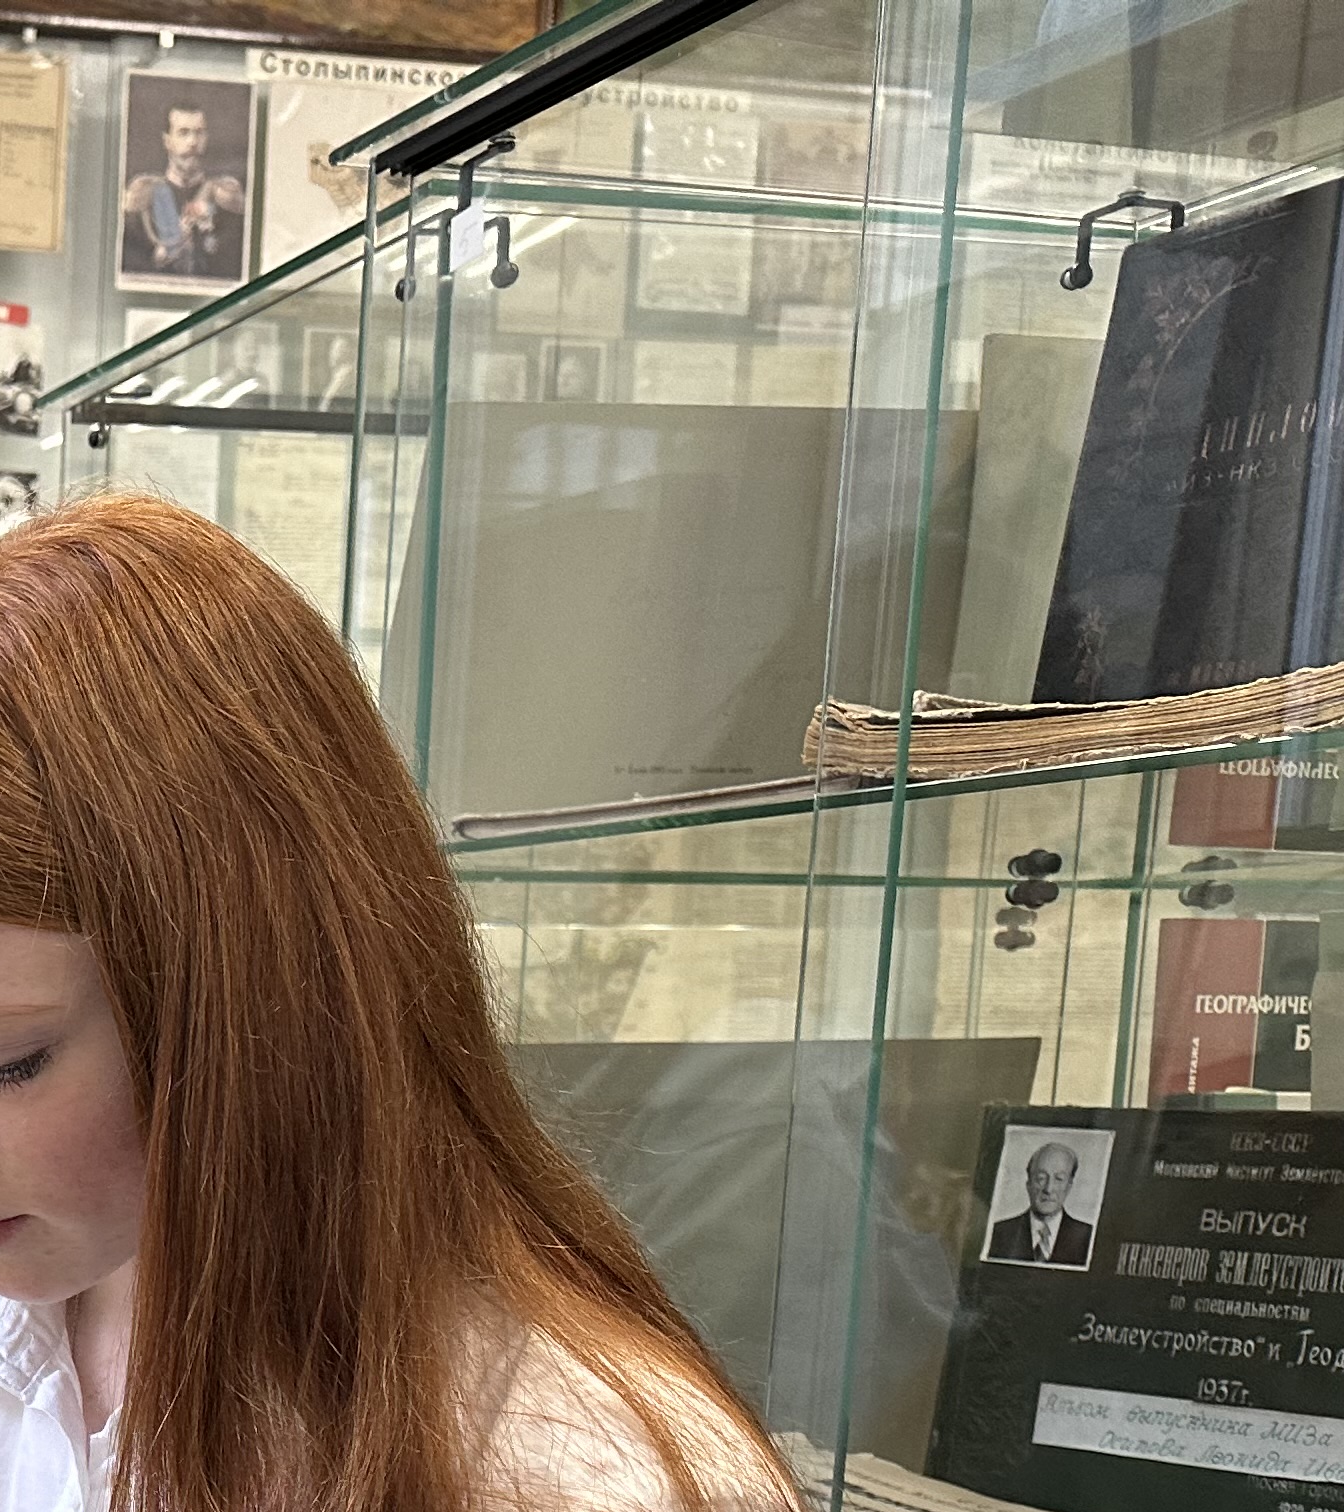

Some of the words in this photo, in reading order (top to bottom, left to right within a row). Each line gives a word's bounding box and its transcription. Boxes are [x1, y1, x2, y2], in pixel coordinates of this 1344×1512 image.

[574, 87, 739, 113] устройство
[1200, 1209, 1308, 1238] ВЫПУСК
[1169, 1296, 1186, 1311] по
[1194, 1296, 1311, 1322] специальностям
[1268, 1343, 1280, 1361] и
